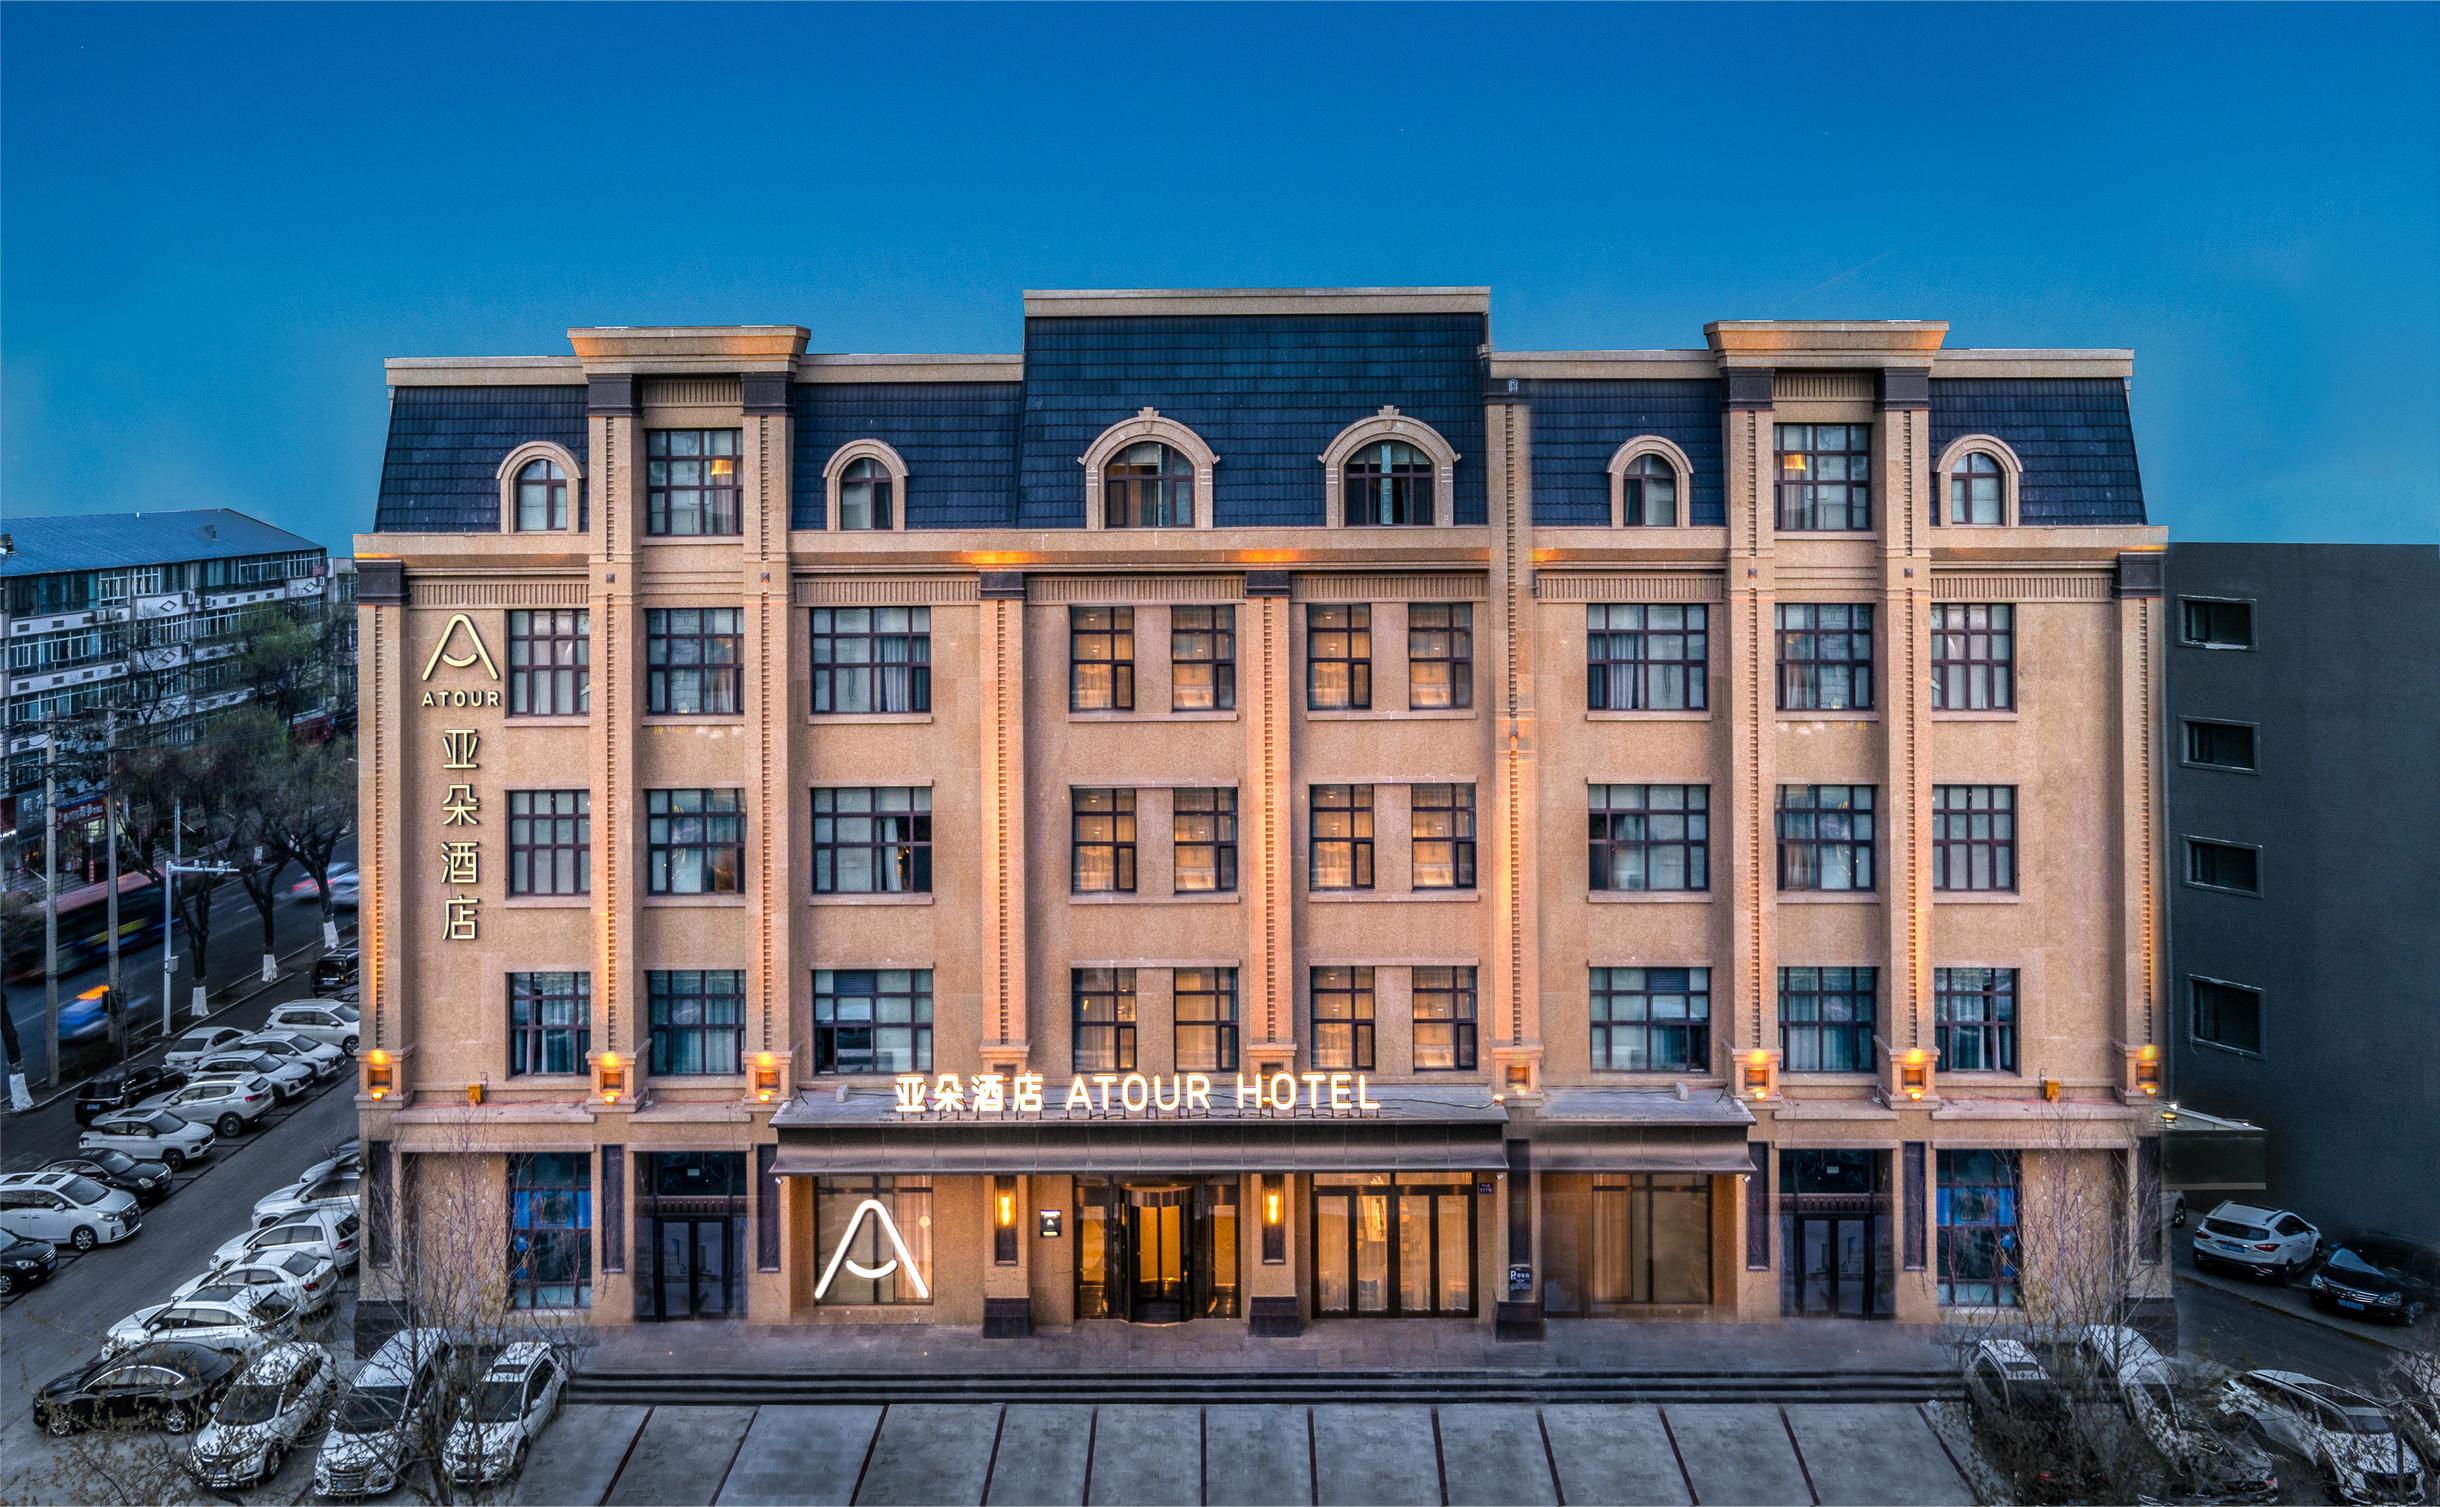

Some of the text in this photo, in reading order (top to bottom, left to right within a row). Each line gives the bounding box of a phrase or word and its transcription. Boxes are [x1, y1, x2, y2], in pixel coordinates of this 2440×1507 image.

[421, 690, 500, 707] ATOUR
[440, 728, 479, 940] 亚朵酒店
[894, 1071, 1381, 1112] 亚朵酒店 ATOUR HOTEL
